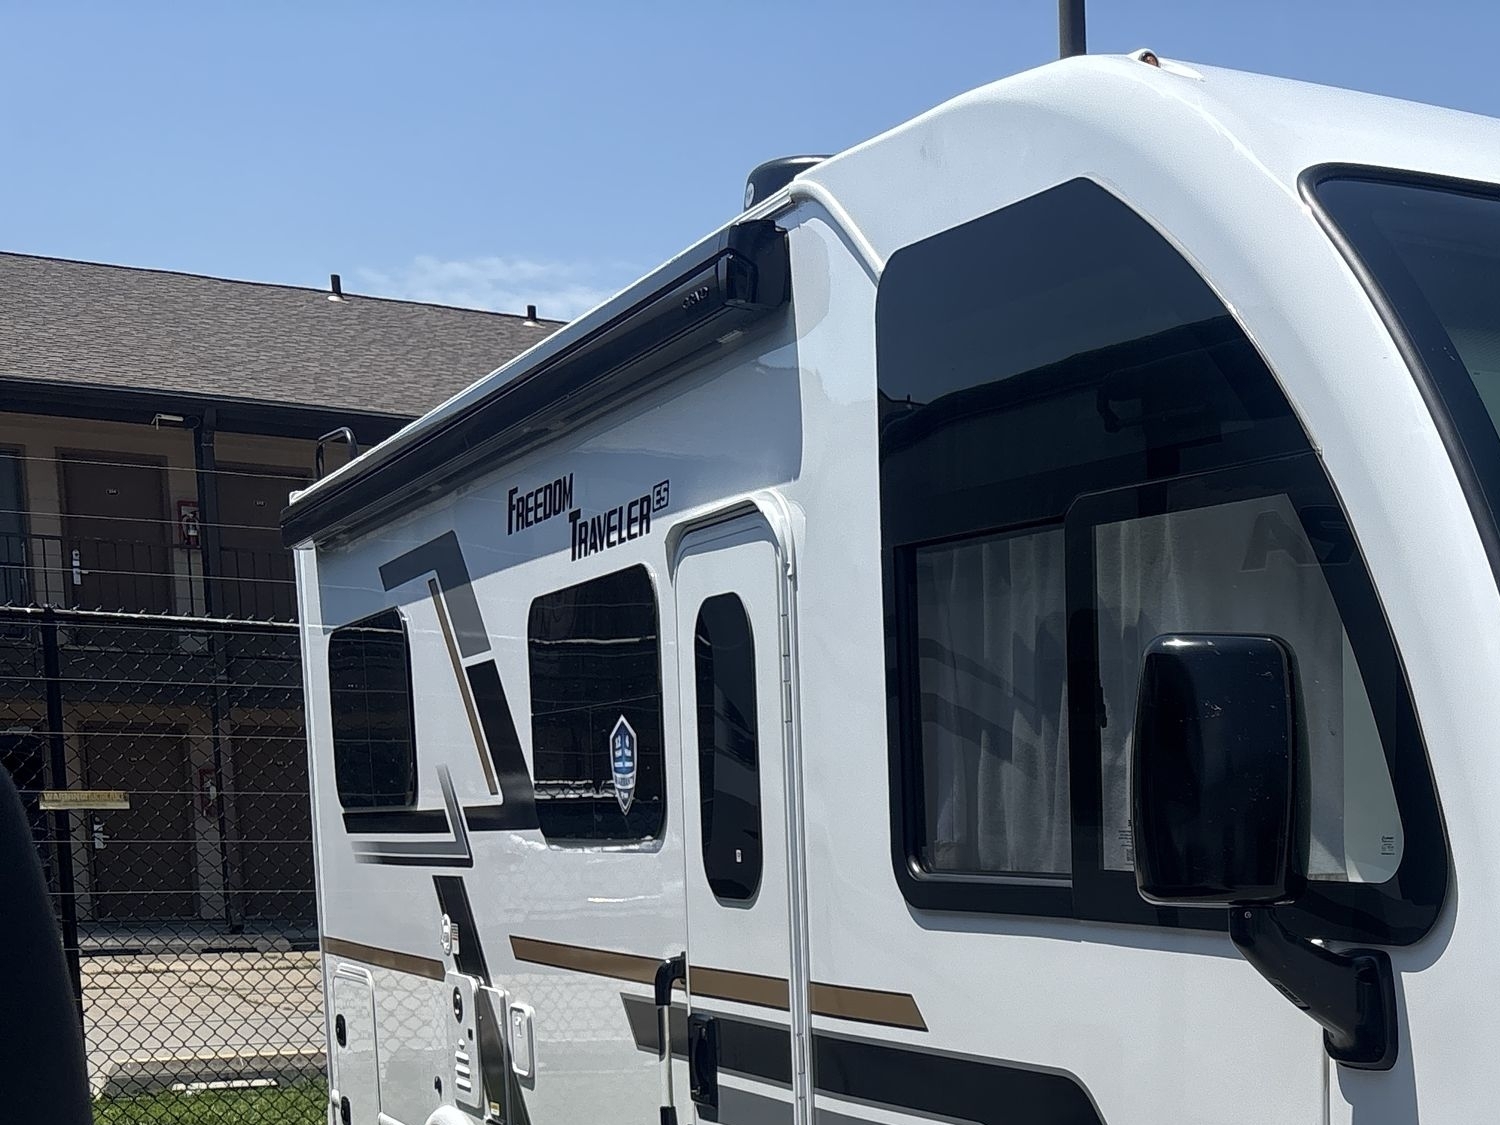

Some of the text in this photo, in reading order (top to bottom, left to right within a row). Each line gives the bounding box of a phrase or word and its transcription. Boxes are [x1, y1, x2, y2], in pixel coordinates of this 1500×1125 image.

[508, 473, 574, 535] FREEDOM
[569, 479, 670, 562] TRAVELER ES
